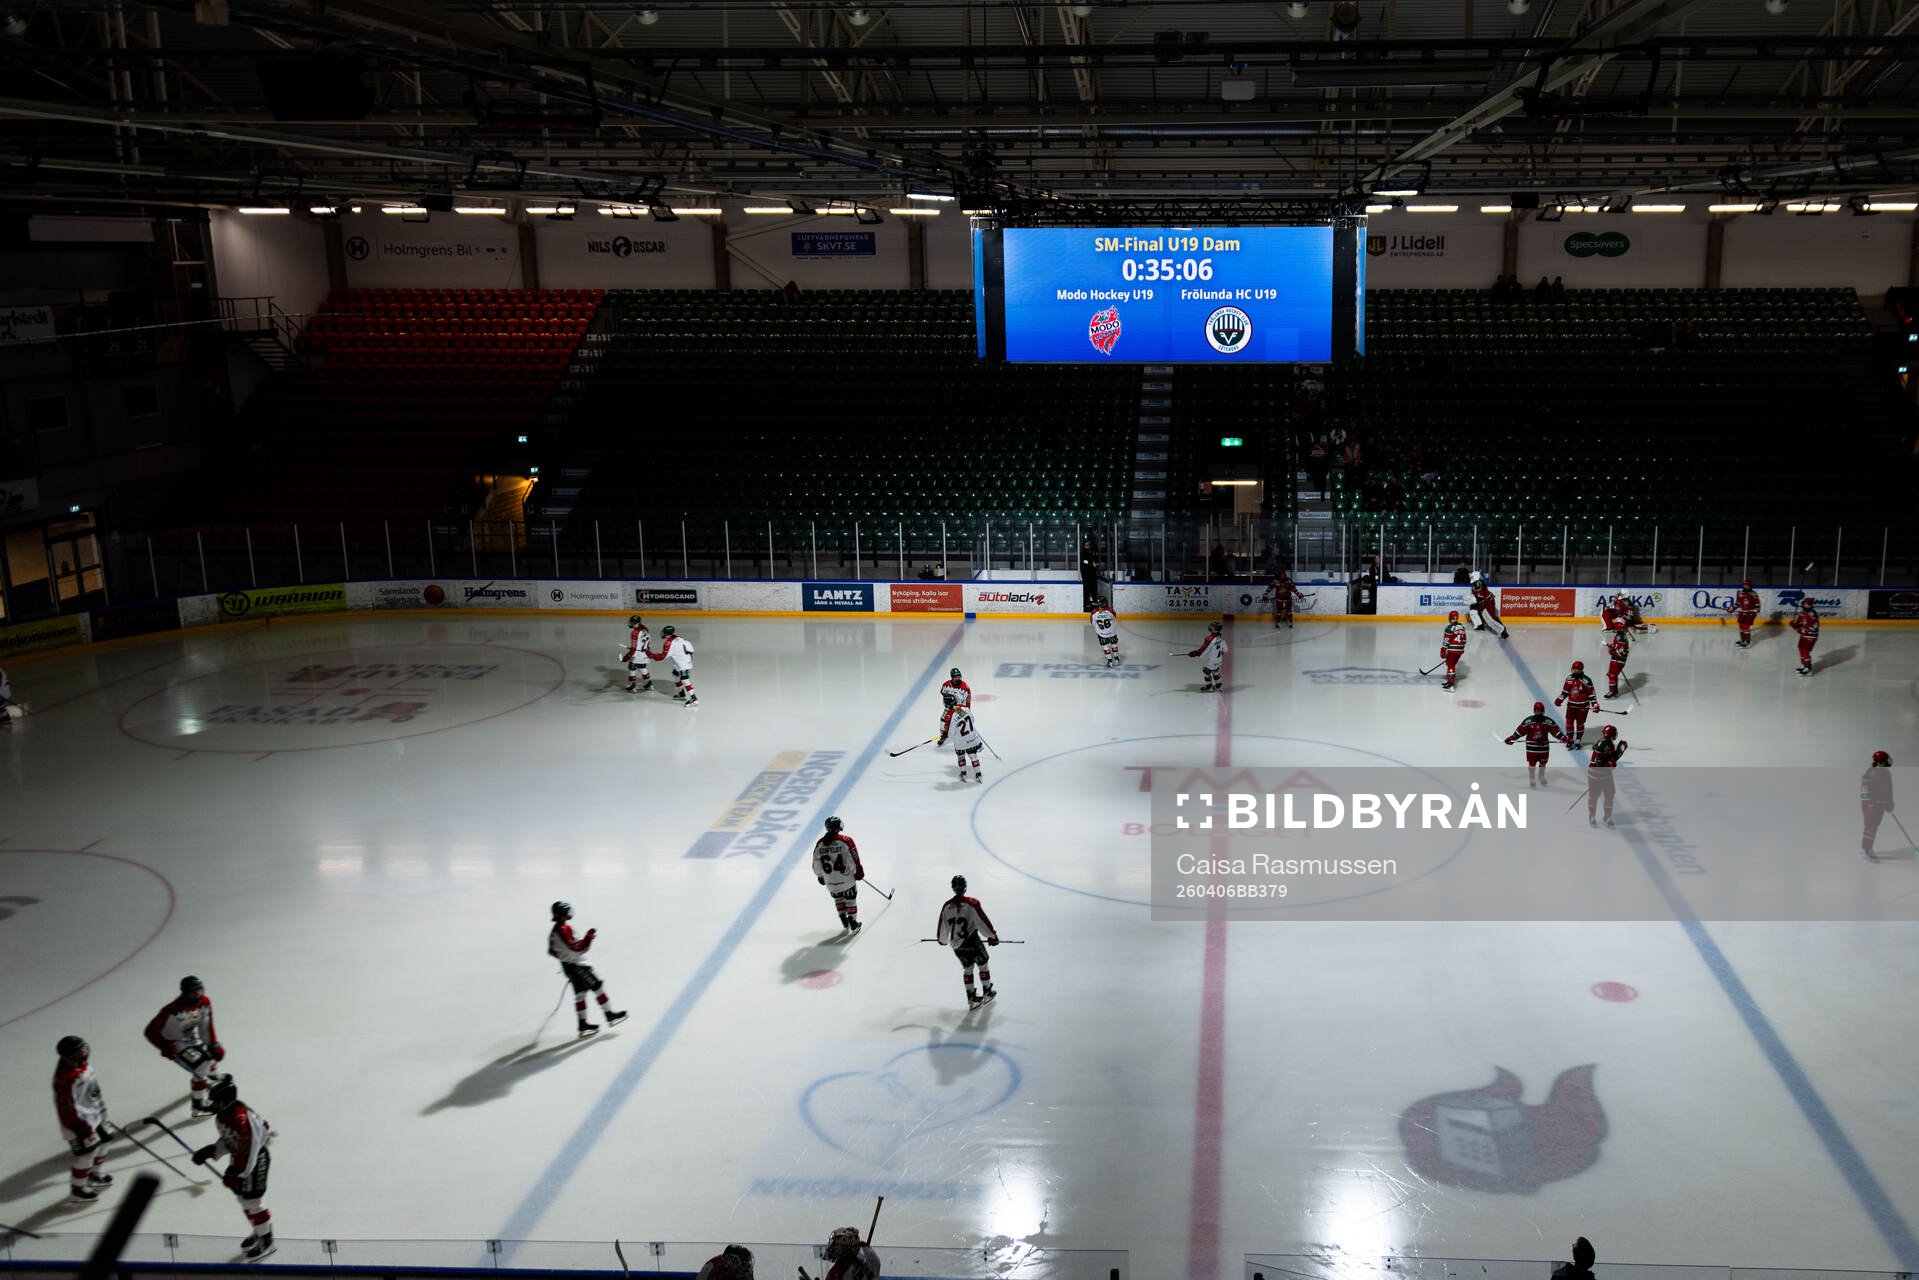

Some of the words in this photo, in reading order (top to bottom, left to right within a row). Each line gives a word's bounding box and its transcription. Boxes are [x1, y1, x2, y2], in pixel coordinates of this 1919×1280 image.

[587, 241, 611, 253] NILS
[633, 241, 666, 253] OSCAR
[1095, 236, 1164, 252] SM-Final
[1168, 237, 1199, 252] U19
[1203, 237, 1241, 252] Dam
[1390, 235, 1397, 250] J
[1402, 235, 1445, 250] Lidell
[383, 243, 454, 258] Holmgrens
[456, 244, 473, 256] Bil
[1122, 258, 1214, 281] 0:35:06
[1056, 289, 1087, 301] Modo
[1090, 289, 1130, 303] Hockey
[1133, 289, 1155, 301] U19
[1181, 288, 1233, 301] Frölunda
[1236, 289, 1253, 301] HC
[1255, 289, 1278, 301] U19
[1090, 320, 1120, 335] MODO
[254, 590, 344, 607] WARRIOR
[464, 586, 528, 601] Holmgrens
[643, 591, 697, 602] HYDROSCAND
[813, 589, 864, 601] LANTZ
[1692, 589, 1741, 610] Oca
[957, 715, 974, 737] 27
[772, 750, 848, 805] INGERS
[725, 809, 802, 859] DÄCK
[820, 854, 847, 874] 64
[948, 917, 969, 941] 73
